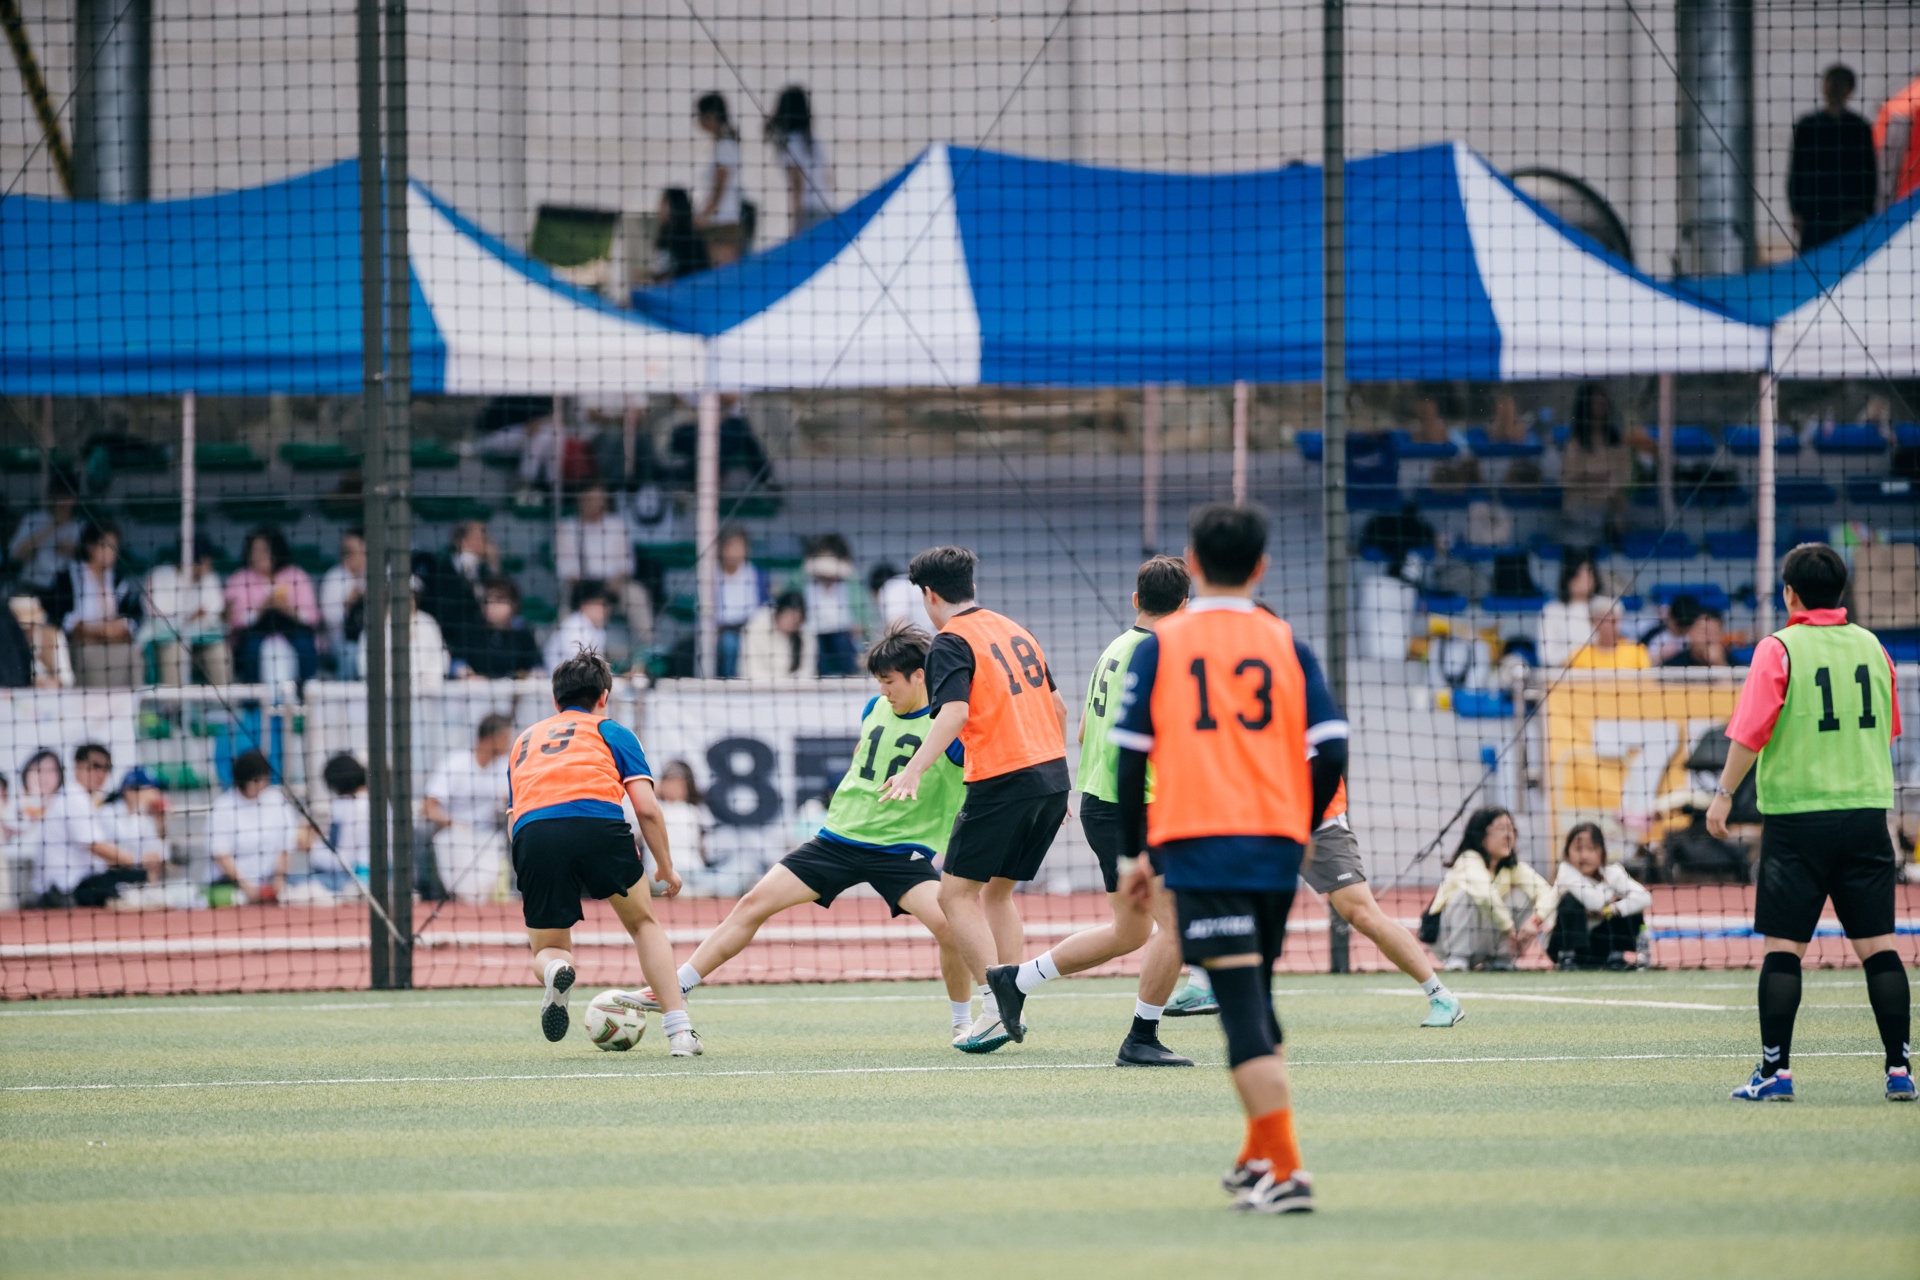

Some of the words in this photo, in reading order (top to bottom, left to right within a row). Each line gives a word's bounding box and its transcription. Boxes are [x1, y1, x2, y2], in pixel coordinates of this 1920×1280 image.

[990, 635, 1045, 696] 18
[1190, 658, 1272, 730] 13
[1815, 664, 1876, 732] 11
[859, 725, 922, 784] 12
